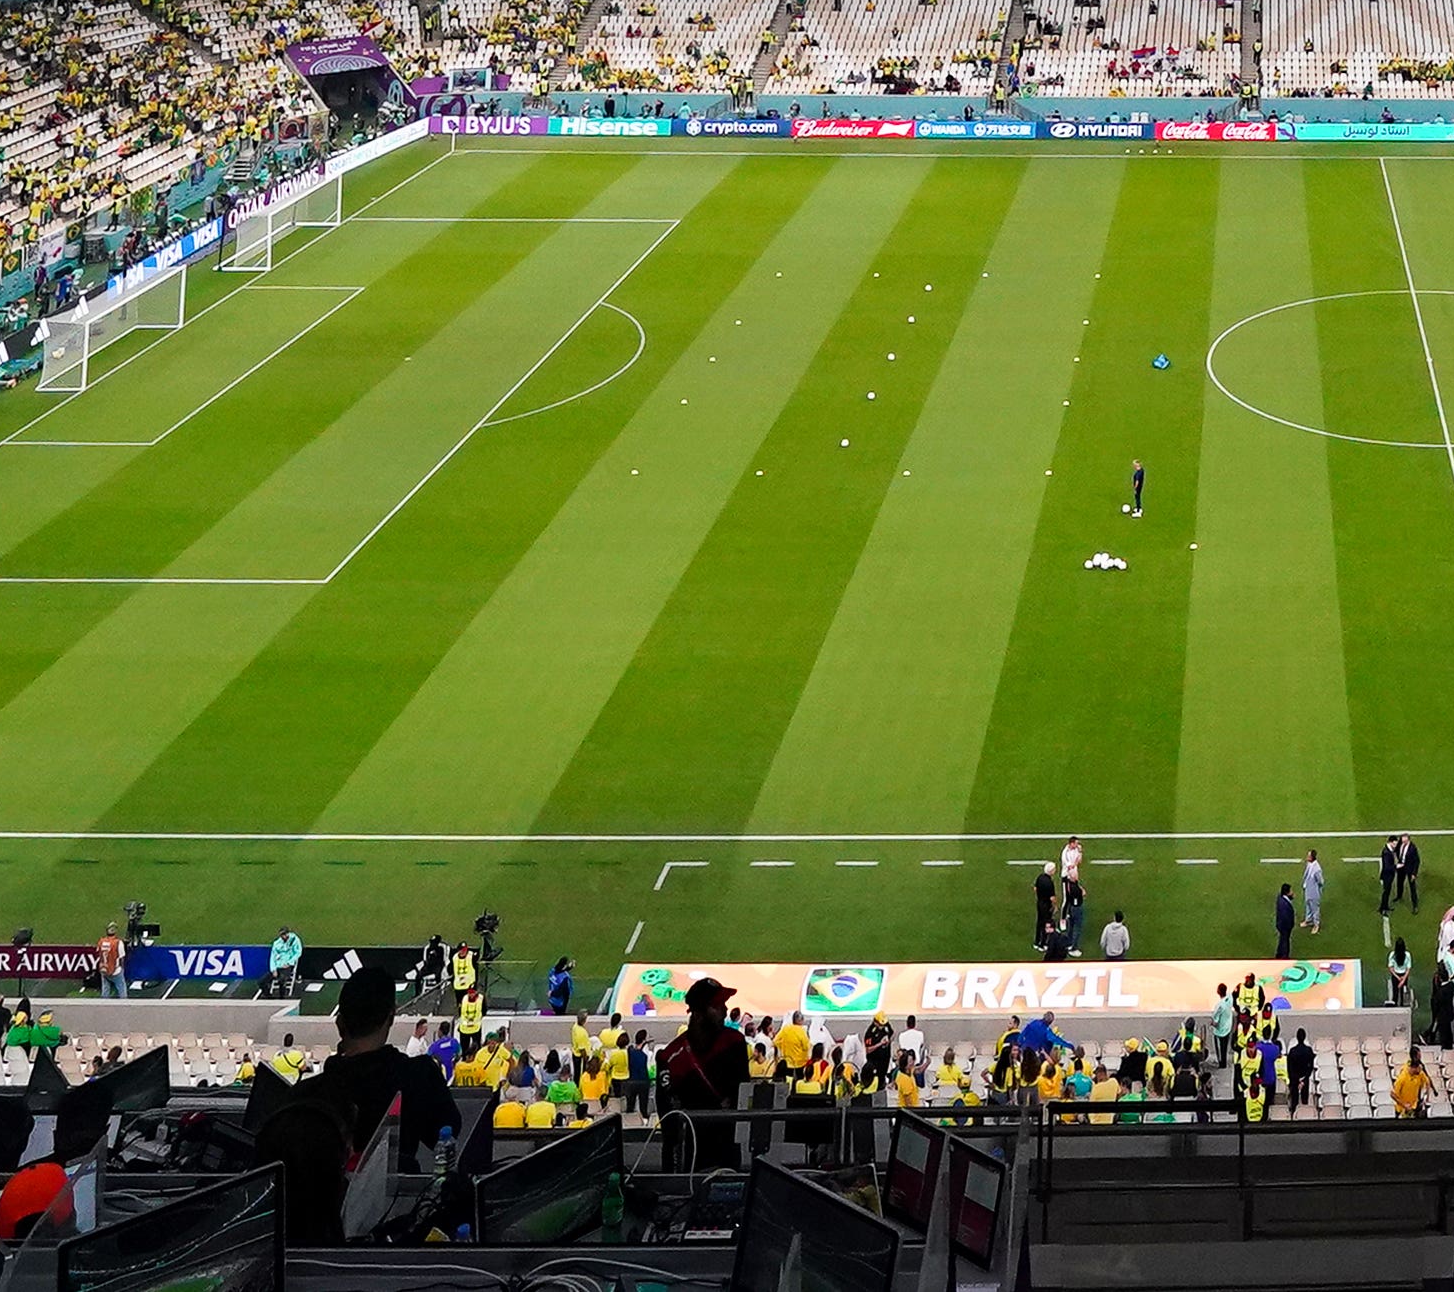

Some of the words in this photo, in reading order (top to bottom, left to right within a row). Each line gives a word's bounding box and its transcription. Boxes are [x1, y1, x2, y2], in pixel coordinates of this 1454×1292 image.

[467, 116, 531, 135] BYJU'S
[561, 117, 658, 135] Hisense
[704, 121, 778, 136] crypto.com
[795, 121, 874, 137] Budweiser
[932, 125, 967, 136] WANDA
[1079, 124, 1143, 137] HYUNDAI
[228, 193, 266, 229] QATAR
[265, 166, 320, 207] AIRWAYS
[194, 219, 221, 251] VISA
[155, 241, 184, 274] VISA
[16, 952, 100, 972] AIRWAY
[168, 950, 244, 976] VISA
[921, 967, 1139, 1009] BRAZIL
